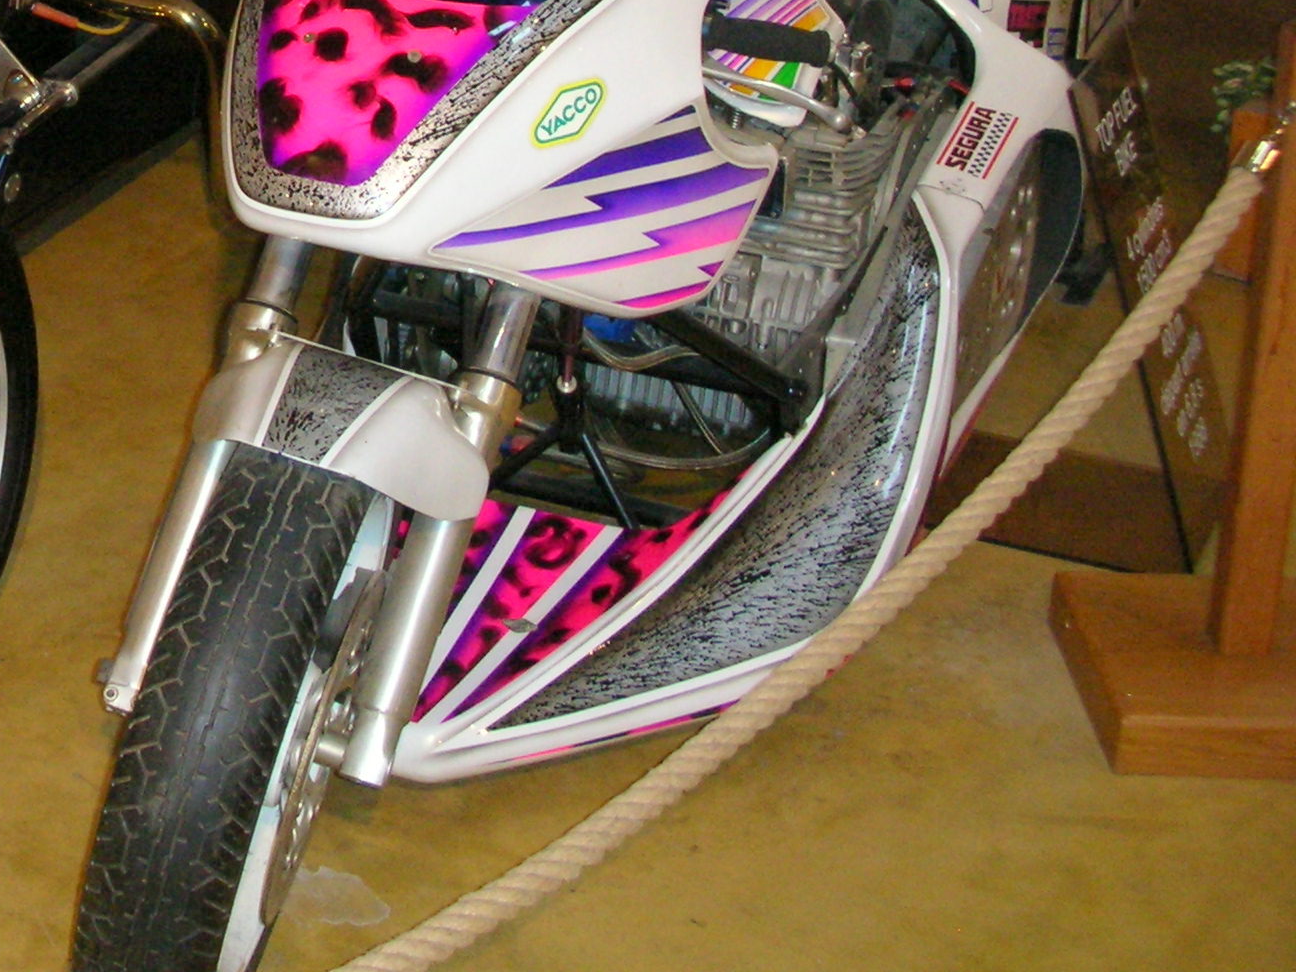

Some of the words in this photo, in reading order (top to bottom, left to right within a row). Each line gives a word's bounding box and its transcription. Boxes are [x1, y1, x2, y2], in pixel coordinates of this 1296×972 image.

[540, 88, 597, 136] YACCO
[945, 106, 997, 172] SEGURA
[1094, 110, 1117, 153] TOP
[1112, 86, 1139, 130] FUEL
